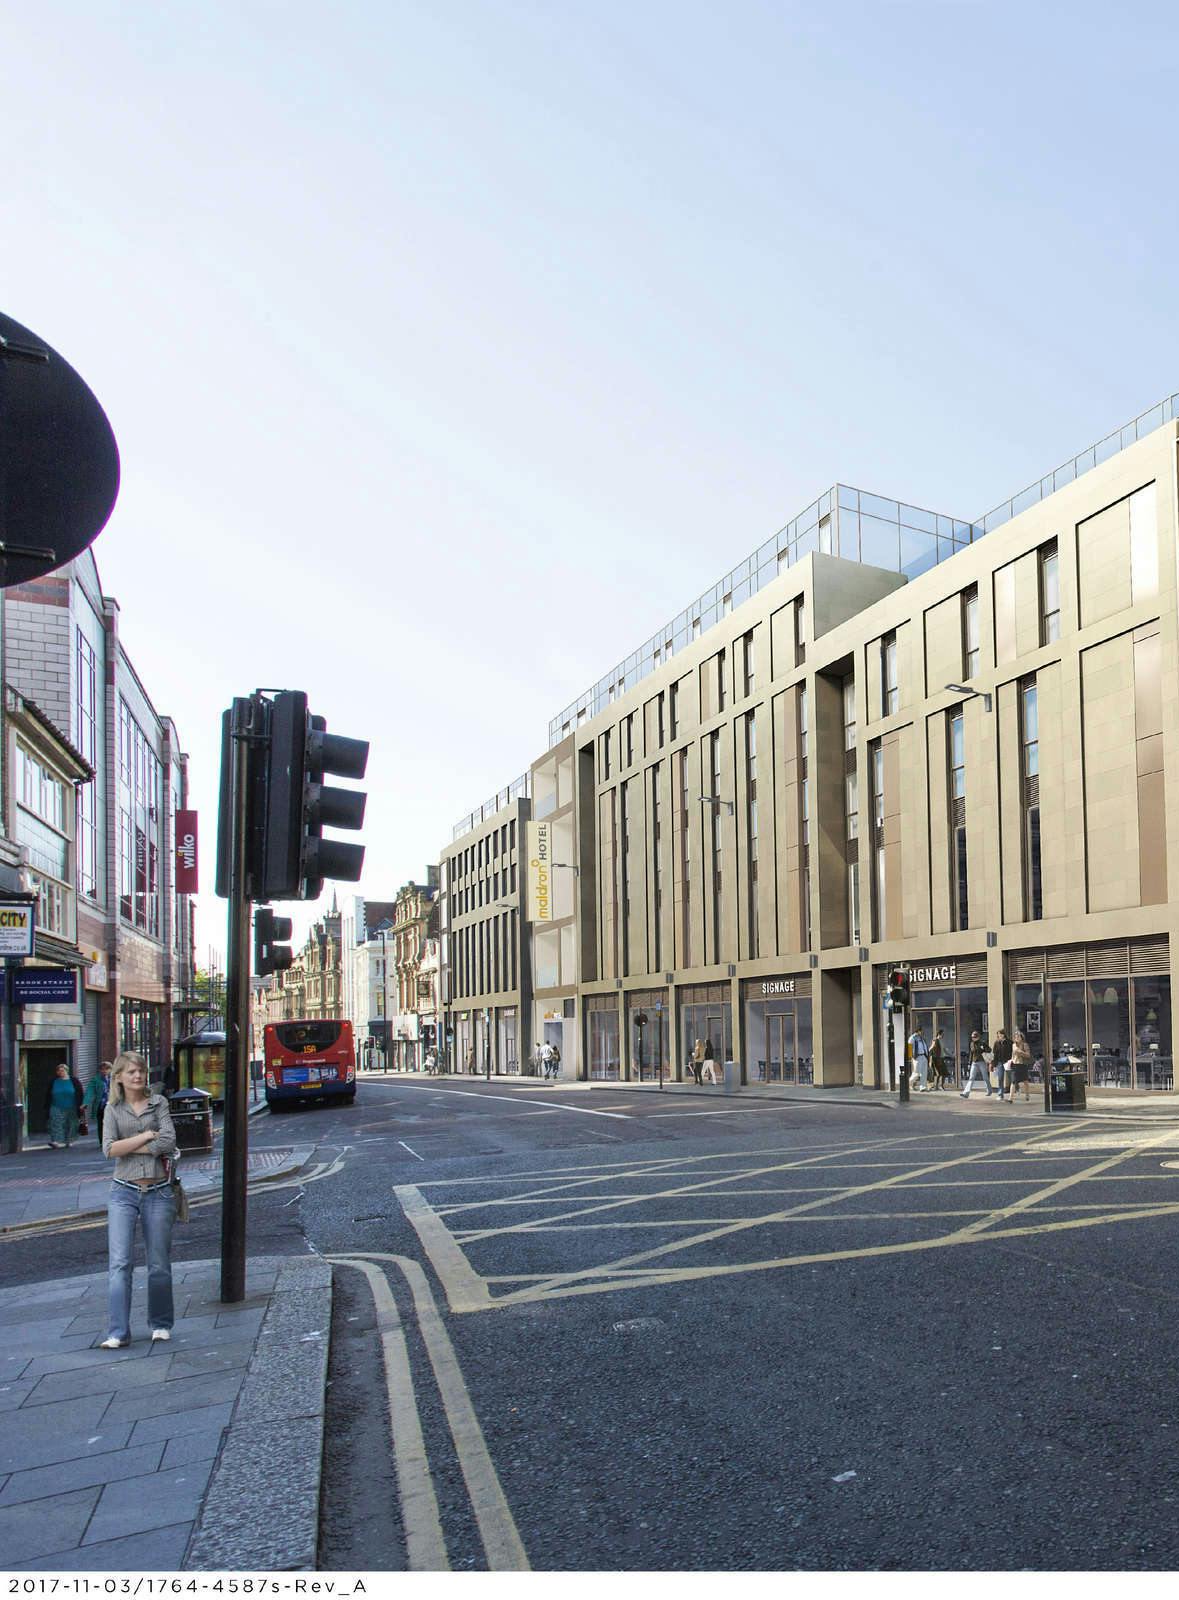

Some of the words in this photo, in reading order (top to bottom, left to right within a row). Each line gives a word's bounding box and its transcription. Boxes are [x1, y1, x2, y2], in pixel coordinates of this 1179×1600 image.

[176, 834, 195, 869] wilko
[538, 824, 548, 861] HOTEL
[535, 865, 548, 919] maldron
[0, 911, 27, 928] CITY
[761, 980, 795, 994] SIGNAGE
